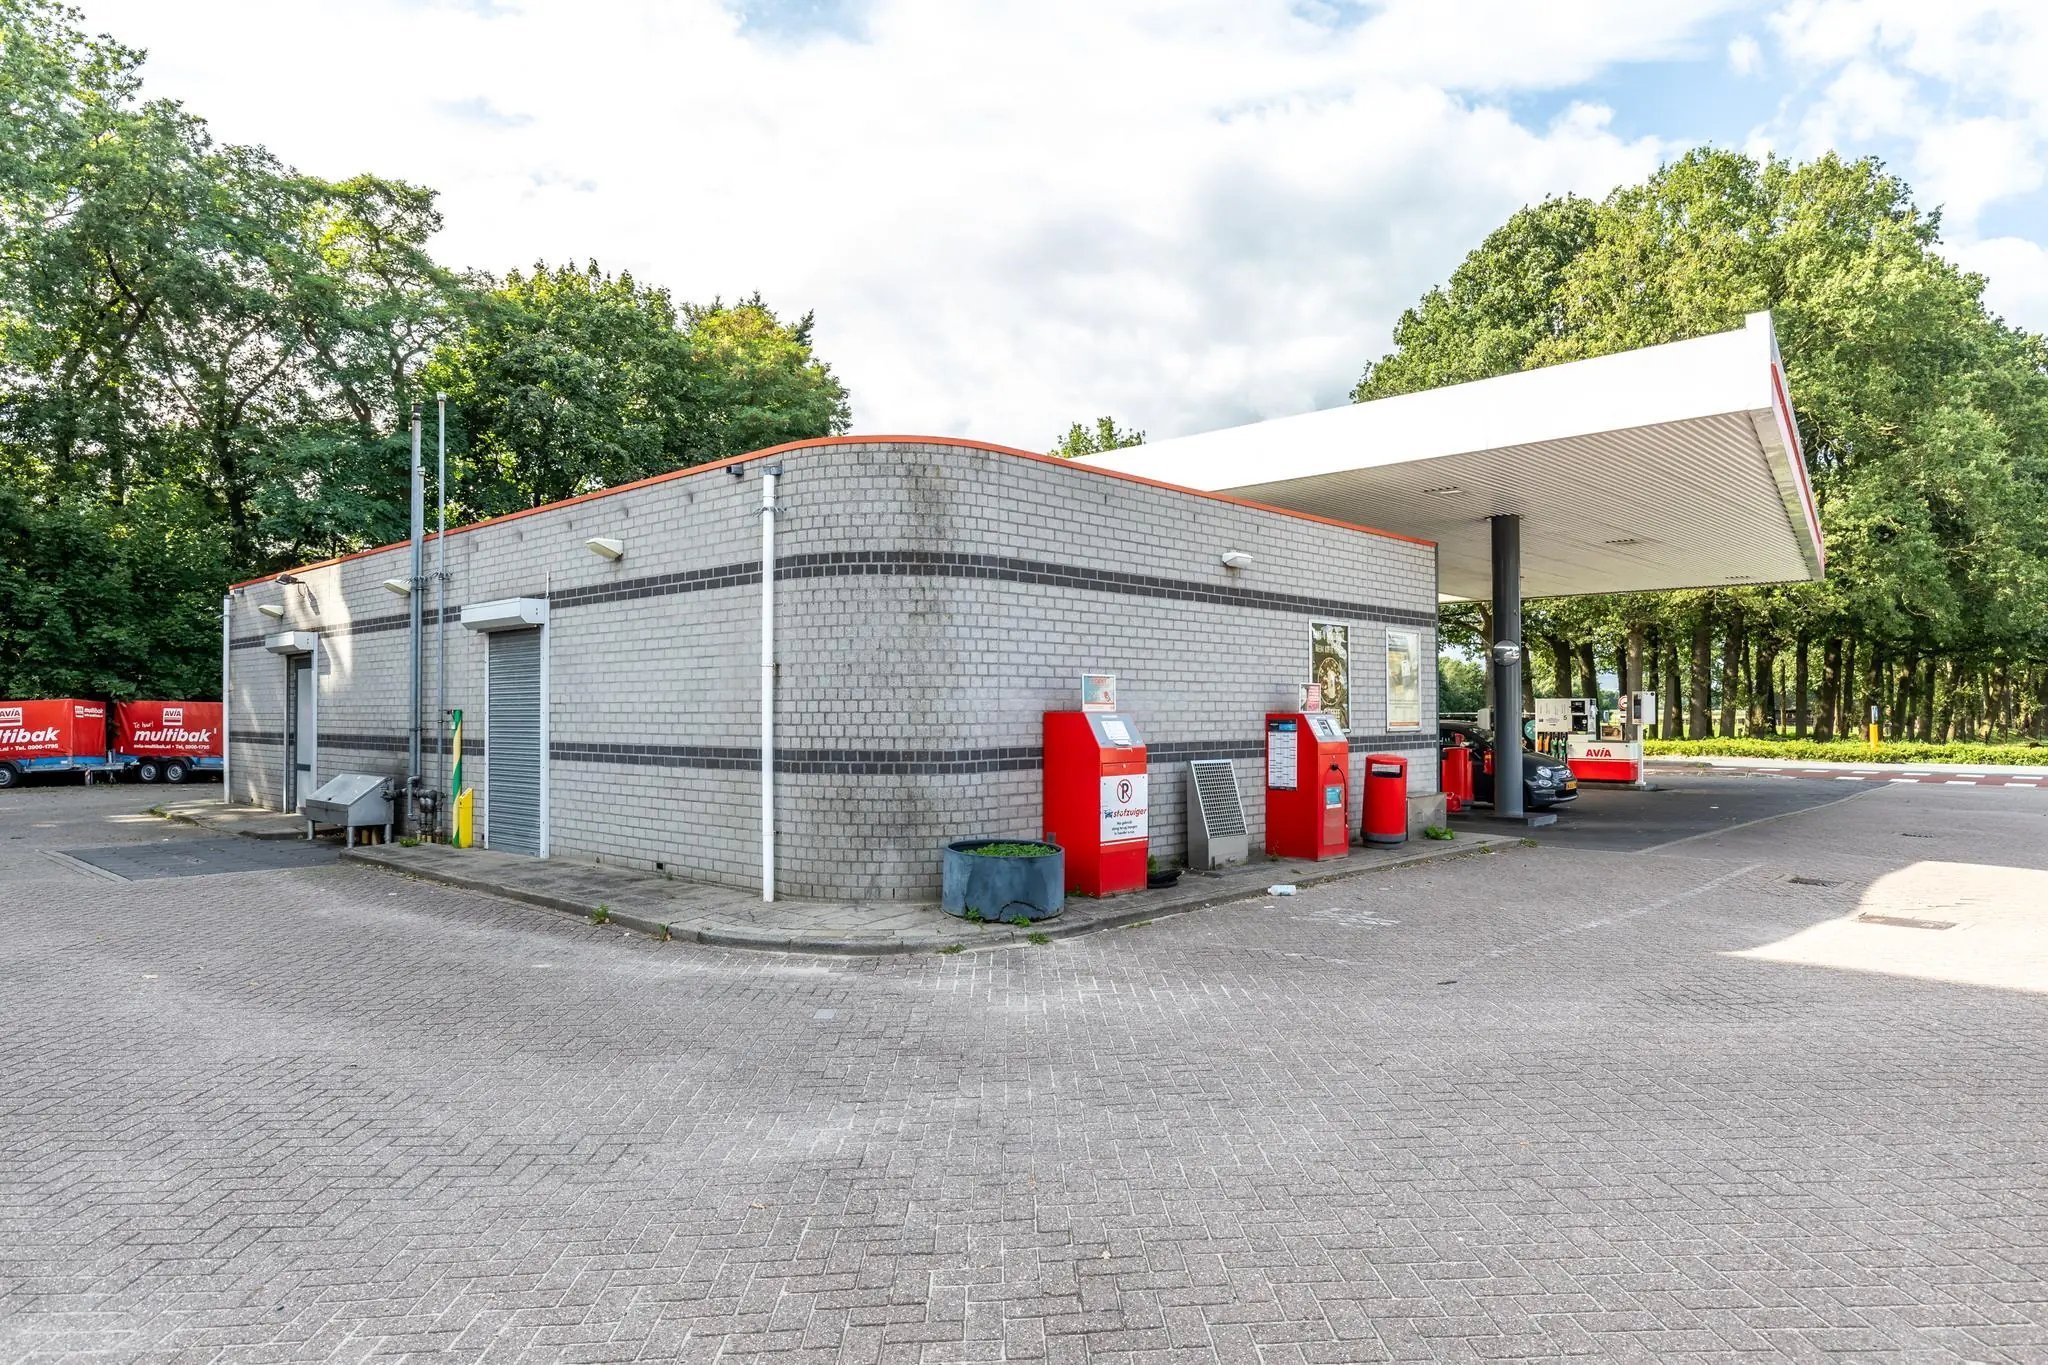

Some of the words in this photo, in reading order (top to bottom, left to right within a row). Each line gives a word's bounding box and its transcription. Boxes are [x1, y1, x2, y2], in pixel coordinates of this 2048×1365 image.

[134, 728, 212, 742] multibak
[1586, 747, 1611, 757] AVIA
[1113, 808, 1147, 817] stofzuiger
